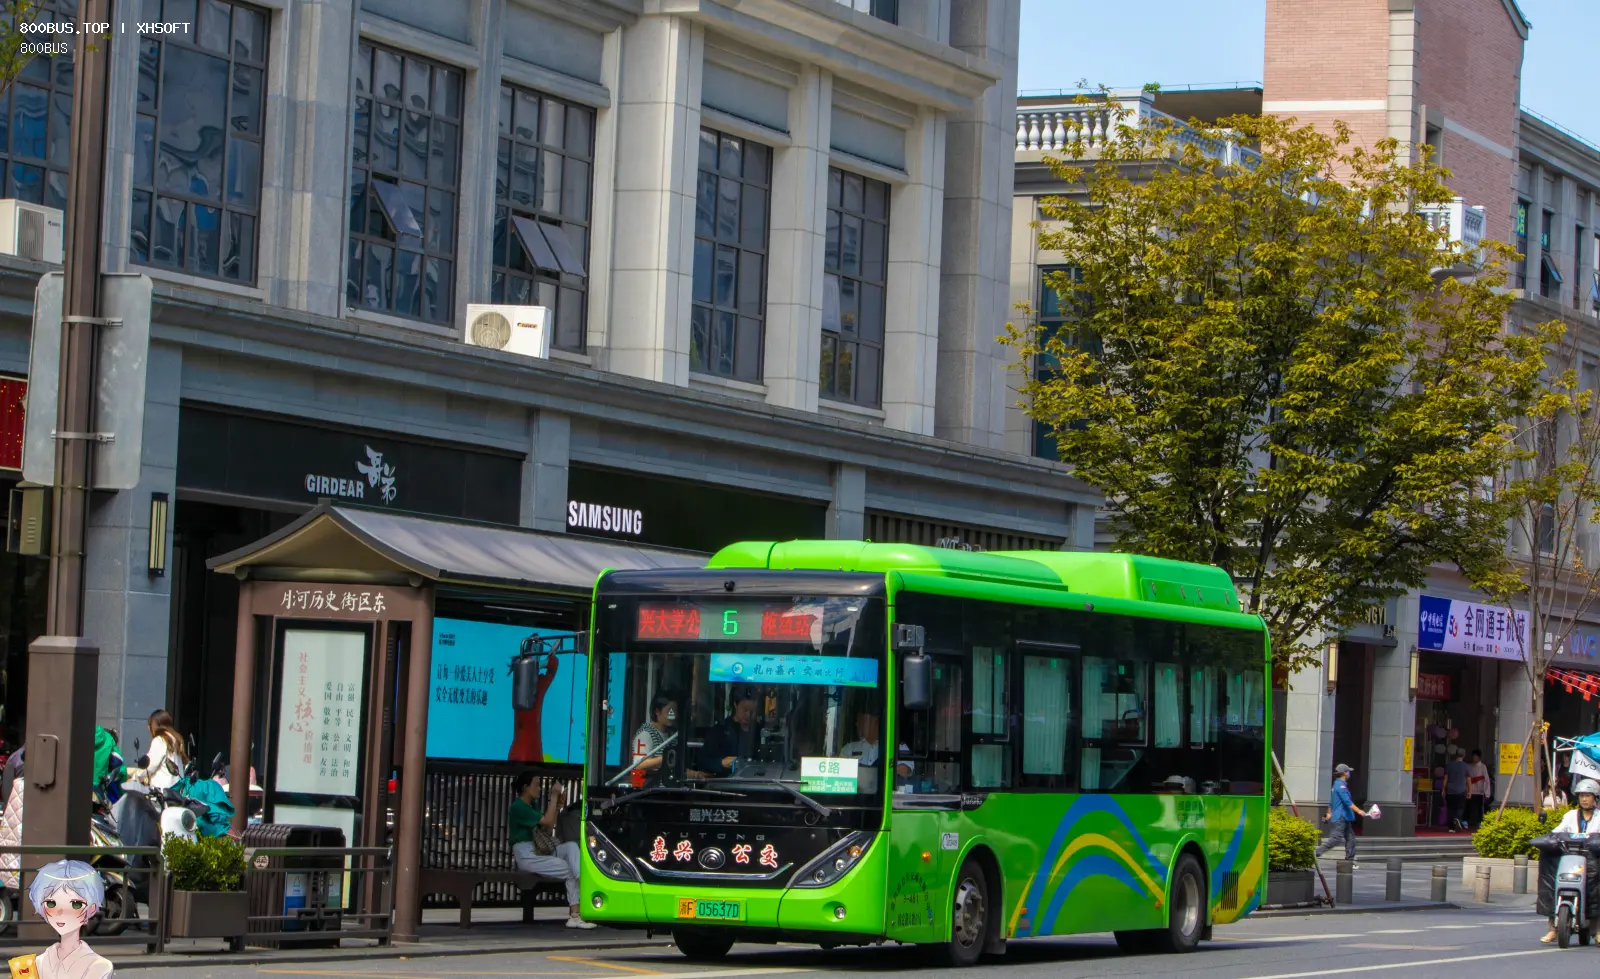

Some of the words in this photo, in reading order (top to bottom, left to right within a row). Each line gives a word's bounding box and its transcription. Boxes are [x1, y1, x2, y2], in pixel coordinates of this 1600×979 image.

[305, 473, 365, 499] GIRDEAR
[568, 500, 642, 535] SAMSUNG
[280, 589, 387, 613] 月河历史街区东
[723, 610, 738, 635] 6
[1569, 626, 1597, 657] vivo
[818, 761, 840, 774] 6路
[1574, 758, 1597, 771] vivo
[689, 808, 739, 823] 嘉兴公交
[662, 831, 765, 841] YUTONG
